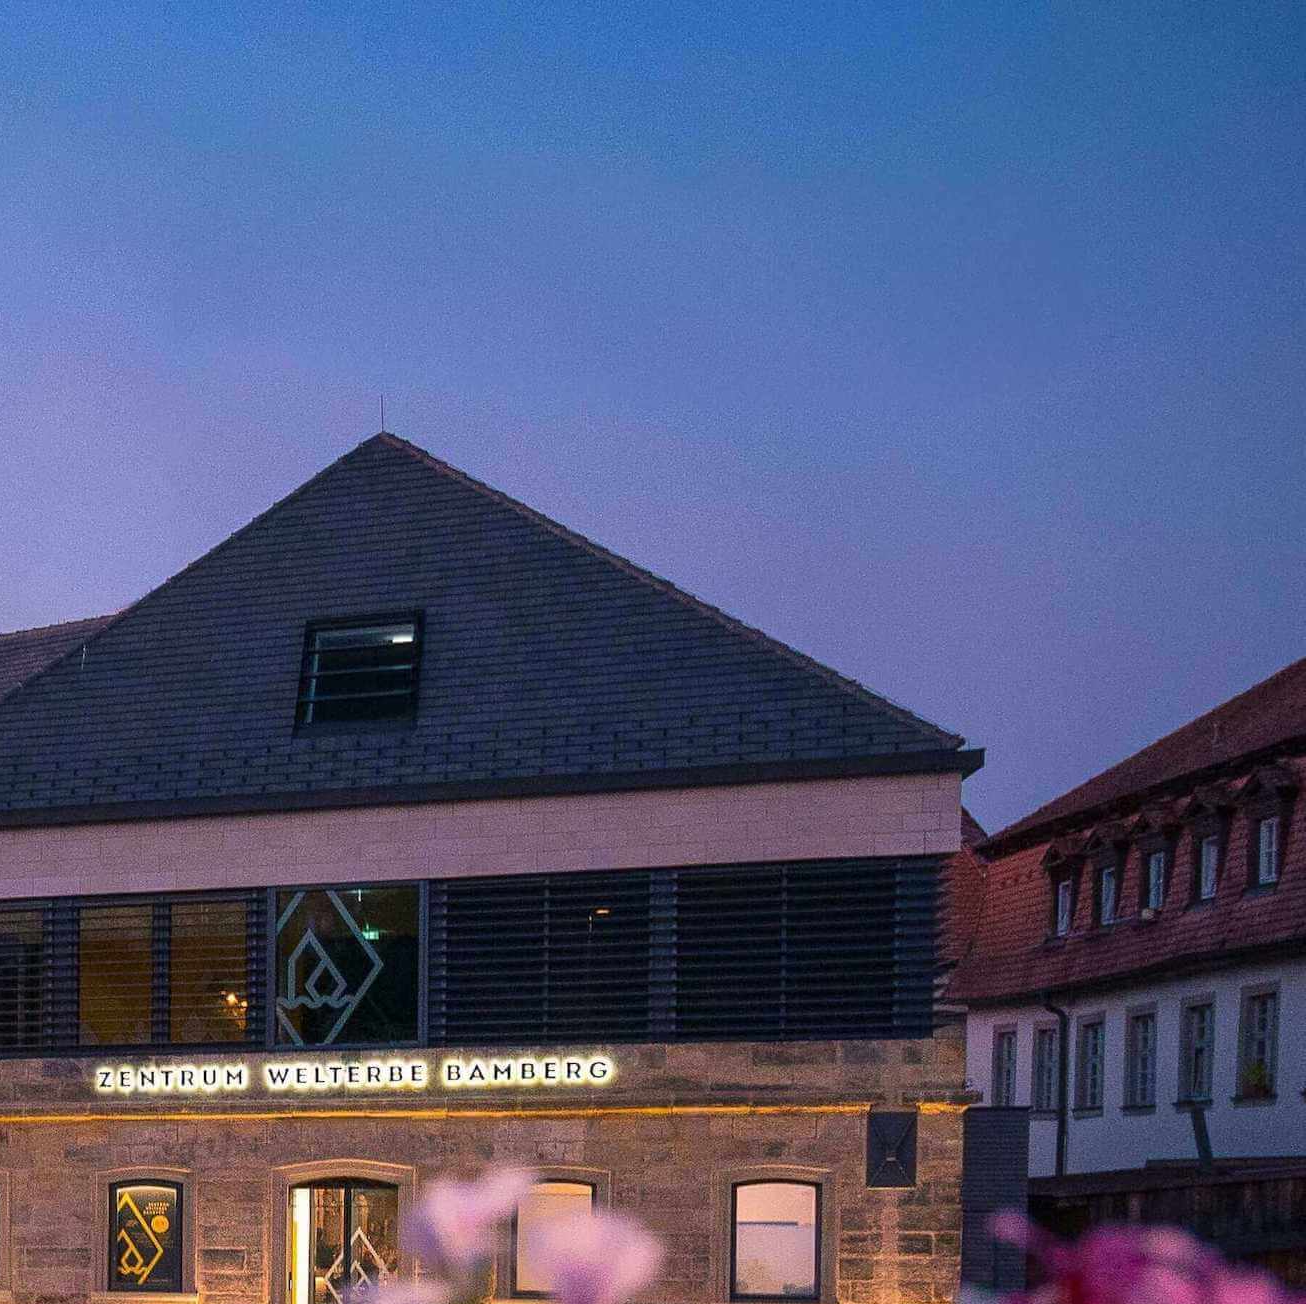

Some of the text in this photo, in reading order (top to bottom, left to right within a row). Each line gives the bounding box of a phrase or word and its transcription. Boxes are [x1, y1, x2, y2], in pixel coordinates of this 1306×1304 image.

[98, 1061, 609, 1088] ZENTRUM WELTERBE BAMBERG
